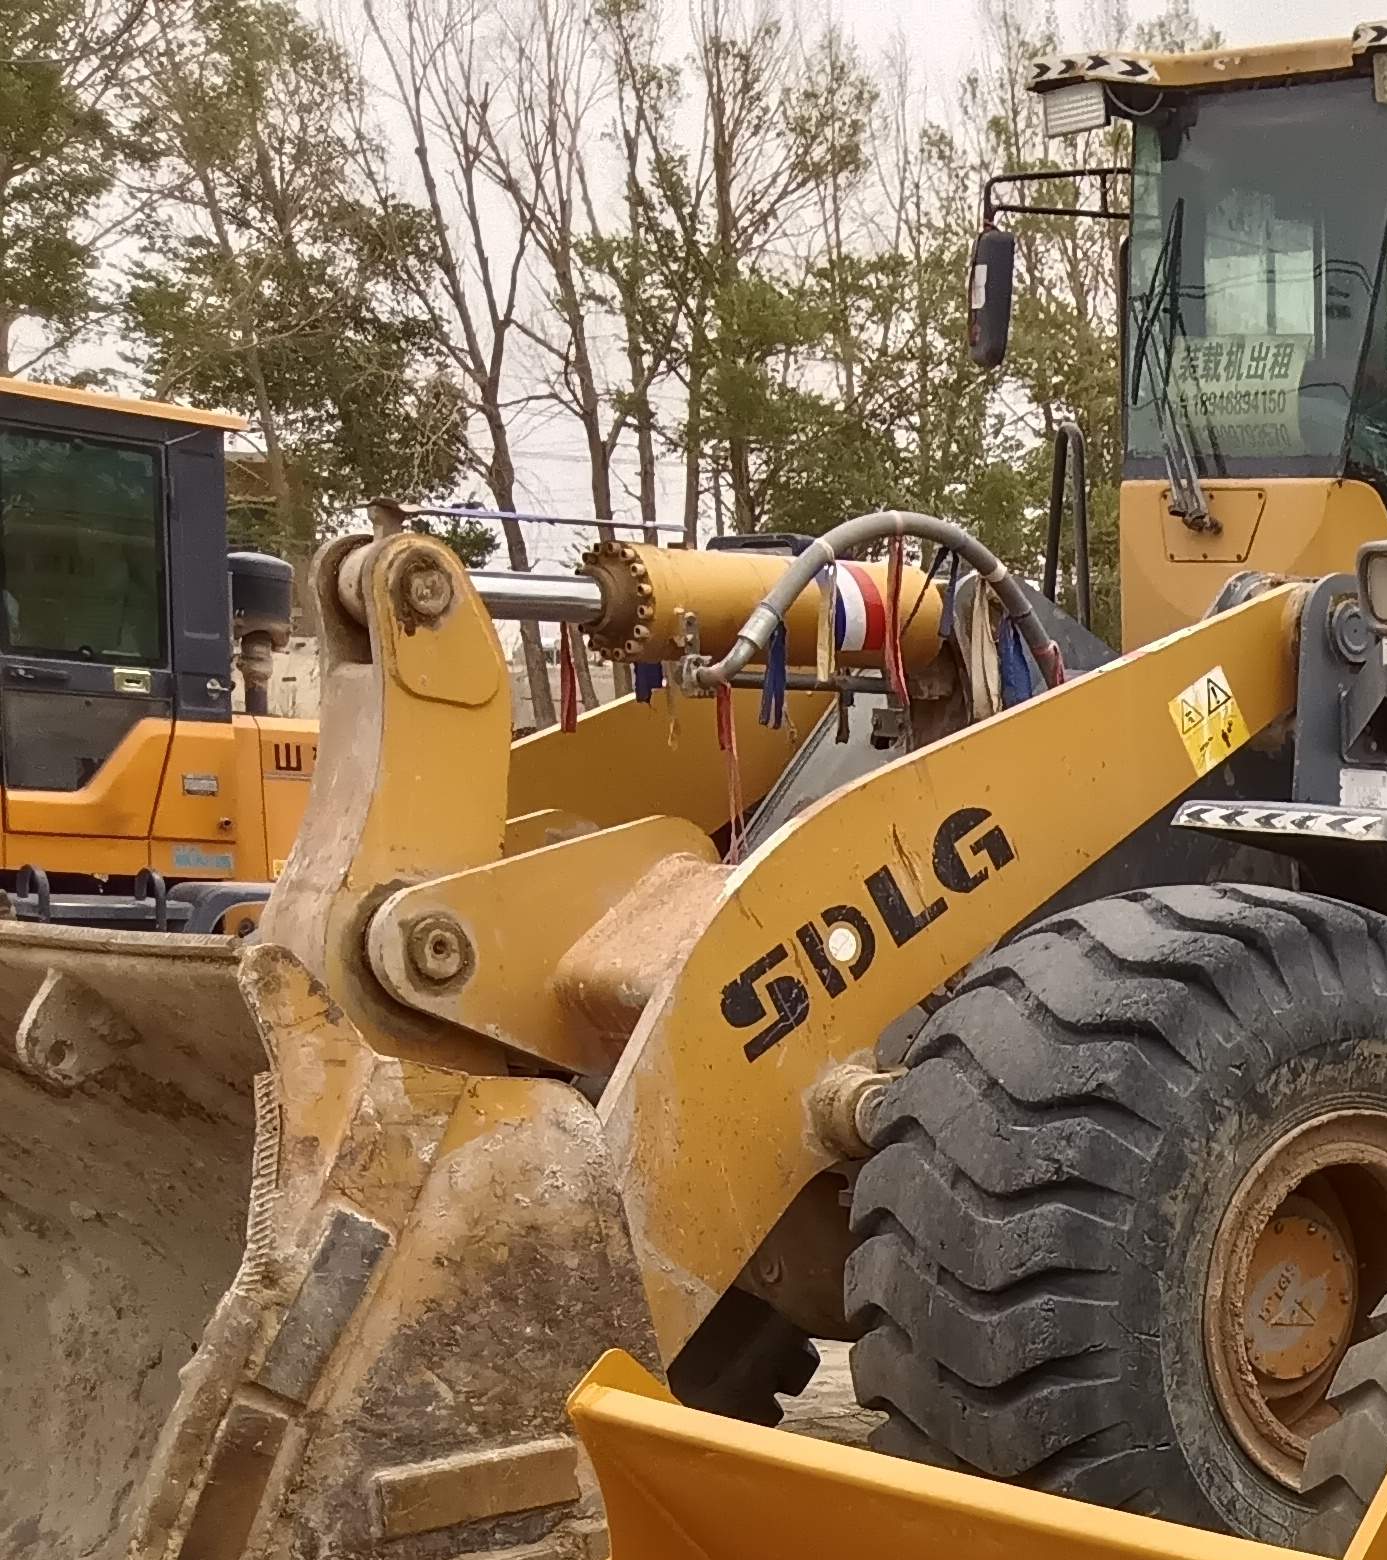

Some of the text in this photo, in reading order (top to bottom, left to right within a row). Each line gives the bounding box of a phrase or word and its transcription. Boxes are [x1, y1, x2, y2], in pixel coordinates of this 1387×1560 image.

[1178, 341, 1295, 383] 装载机出租
[720, 806, 1016, 1064] SDLG
